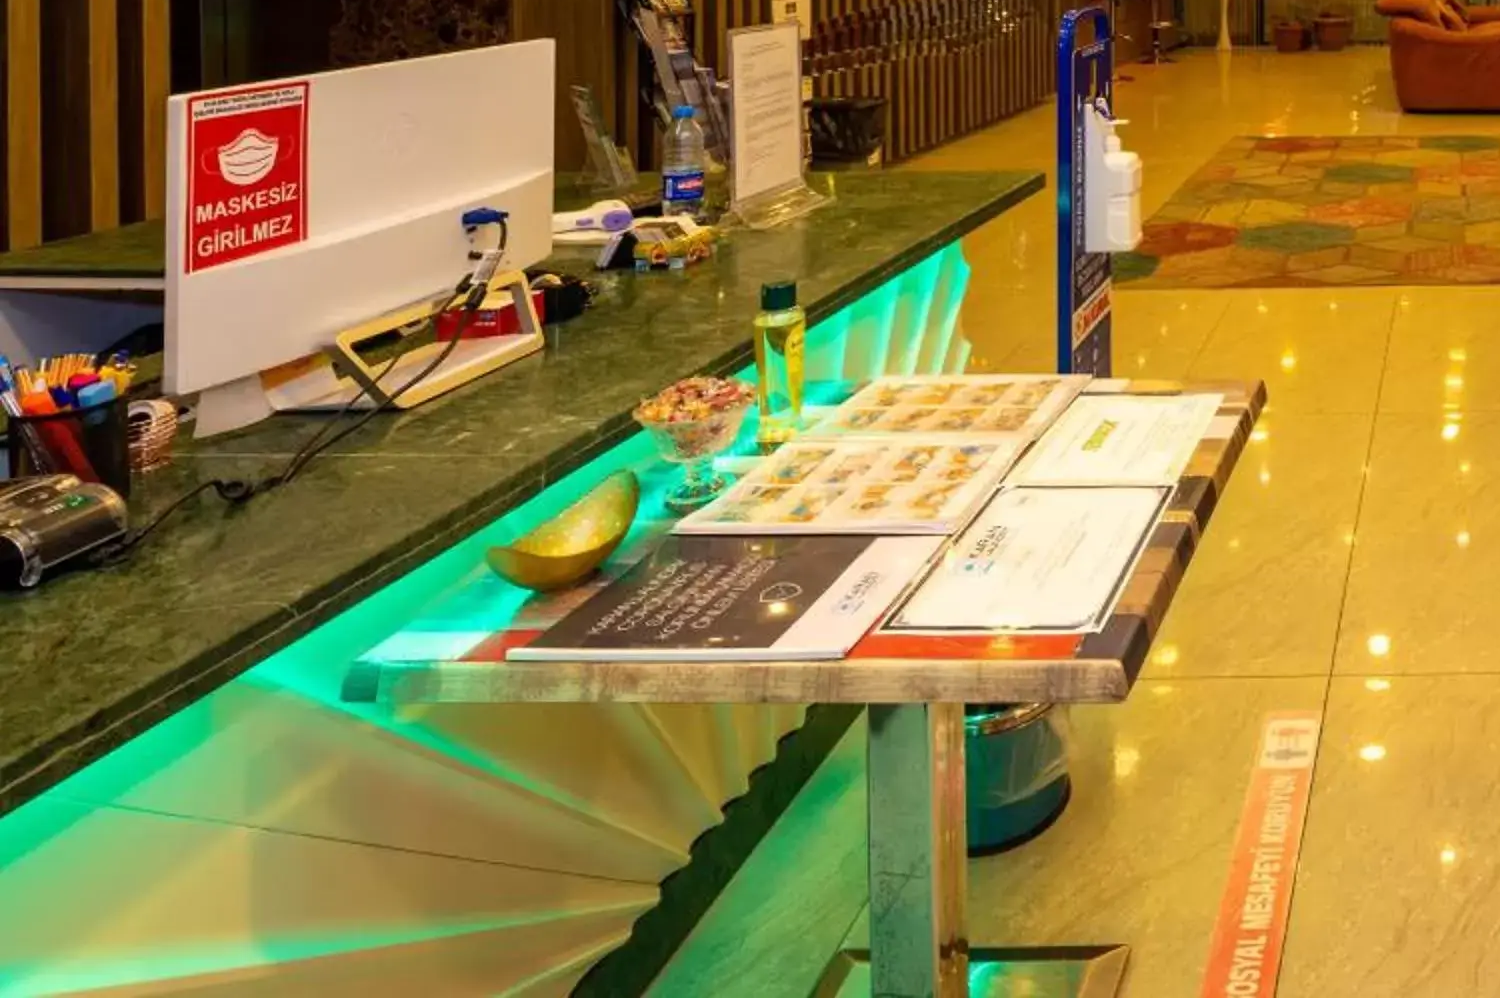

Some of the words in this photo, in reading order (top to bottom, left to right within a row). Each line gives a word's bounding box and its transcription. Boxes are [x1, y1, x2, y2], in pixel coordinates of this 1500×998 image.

[196, 181, 298, 224] MASKESİZ
[197, 213, 294, 258] GİRİLMEZ
[1238, 847, 1286, 930] MESAFEYİ
[1226, 935, 1268, 998] OSYAL
